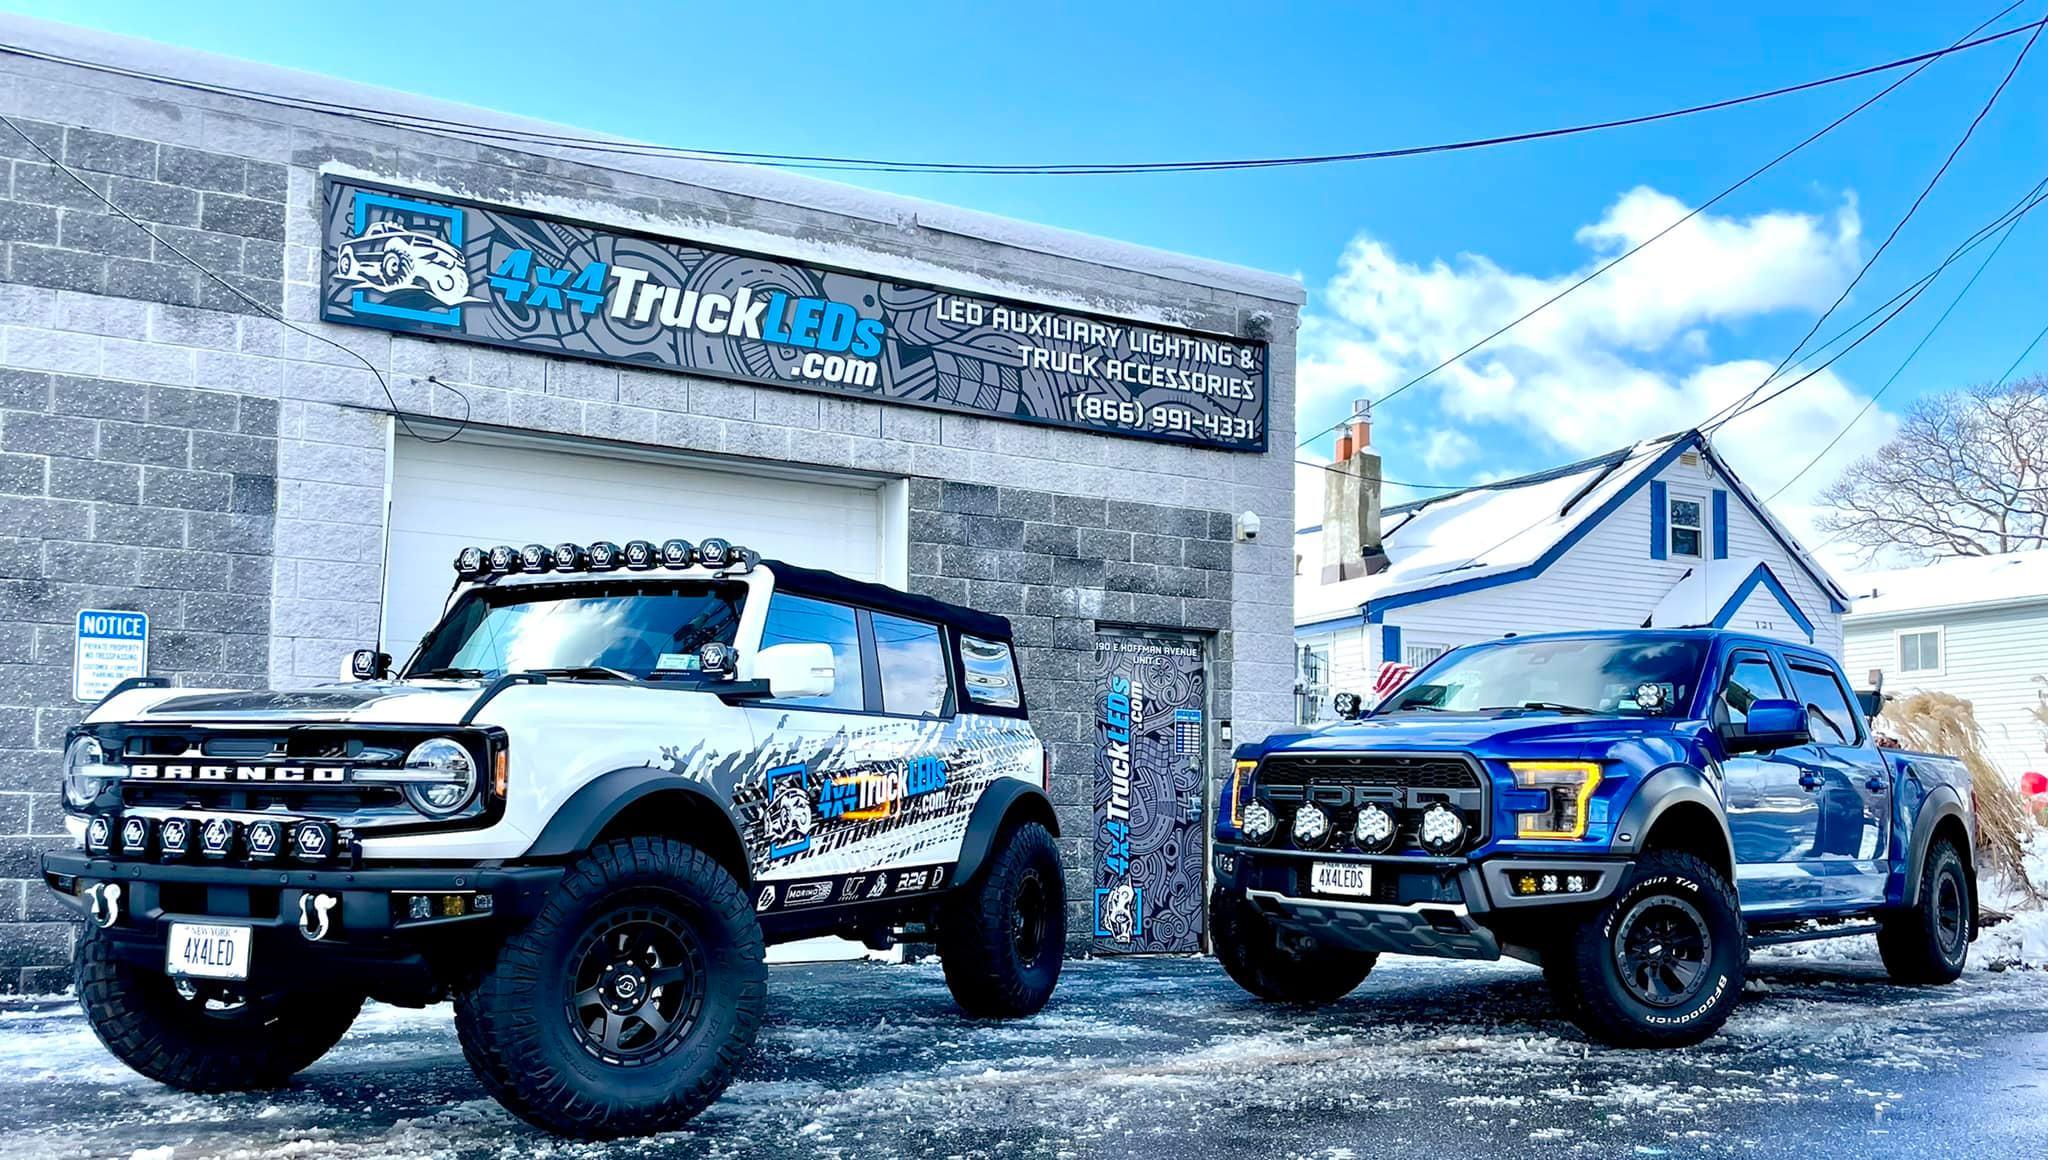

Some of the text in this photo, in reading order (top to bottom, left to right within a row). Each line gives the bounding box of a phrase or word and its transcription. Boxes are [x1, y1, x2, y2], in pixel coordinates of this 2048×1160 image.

[487, 248, 885, 358] 4x4TruckLEDs
[936, 298, 1255, 370] LED AUXILIARY LIGHTING &
[791, 352, 878, 387] .com
[1018, 345, 1255, 400] TRUCK ACCESSORIES
[1075, 393, 1255, 440] (866) 991-4331
[83, 615, 143, 636] NOTICE
[1755, 620, 1773, 630] 121
[1096, 642, 1198, 657] 190 E HOFFMAN AVENUE
[1133, 656, 1161, 665] UNIT C
[1129, 680, 1144, 731] .com
[131, 764, 345, 782] BRONCO
[1319, 868, 1363, 889] 4X4LEDS
[1675, 876, 1699, 893] T/A
[191, 926, 231, 937] NEW YORK
[184, 937, 234, 966] 4X4LED
[1646, 975, 1728, 1025] BFGoodrich
